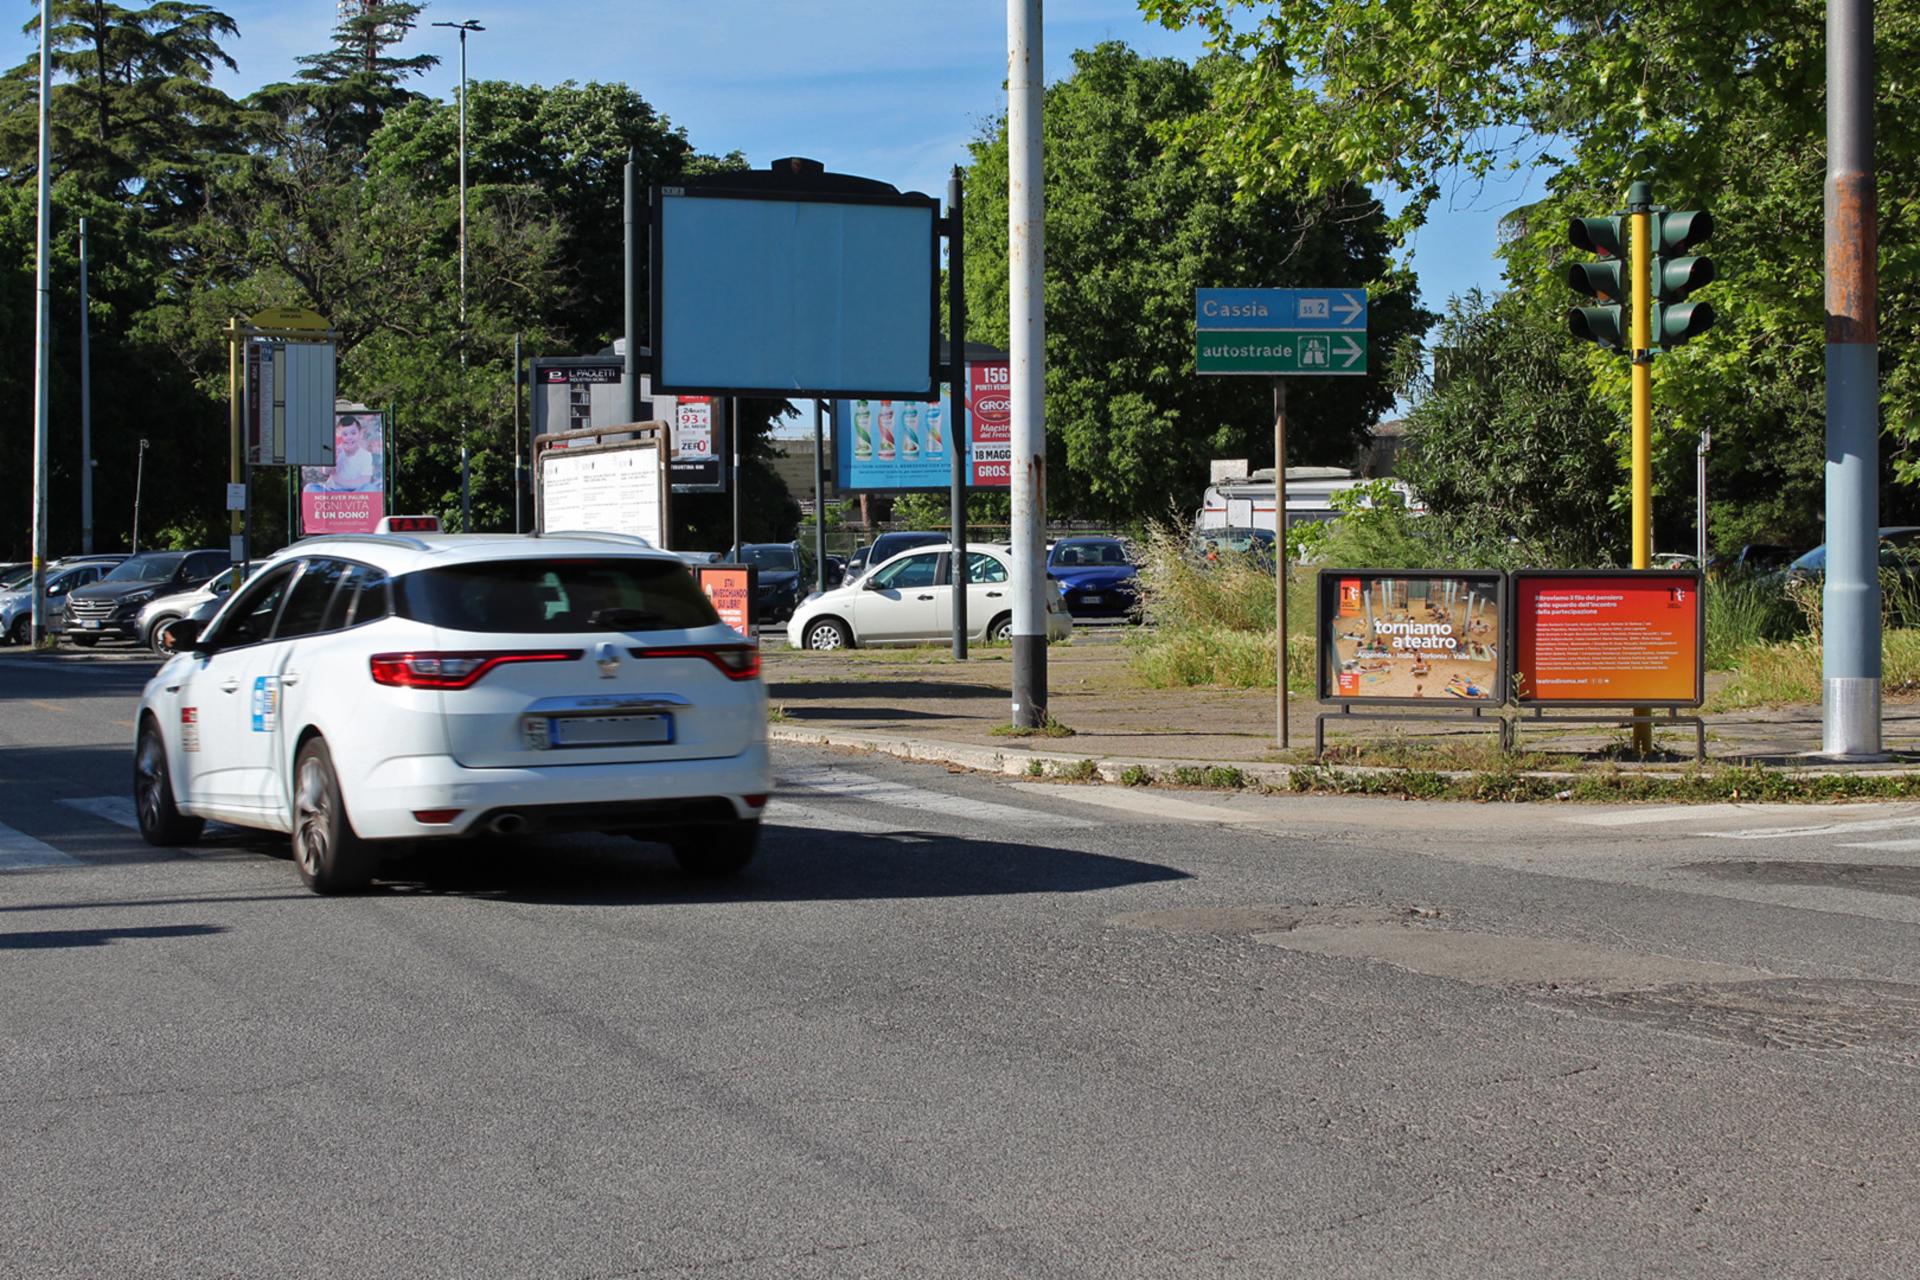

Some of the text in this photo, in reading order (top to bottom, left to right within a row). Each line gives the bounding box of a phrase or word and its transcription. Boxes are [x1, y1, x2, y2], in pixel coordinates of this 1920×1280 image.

[1203, 300, 1269, 317] Cassia
[1318, 302, 1325, 314] 2
[1203, 344, 1293, 358] autostrade
[576, 368, 615, 377] PAOLETTI
[984, 367, 1009, 384] 156
[975, 383, 1011, 391] PUNTI VEND
[979, 400, 1011, 411] GROS
[681, 414, 699, 424] 93
[975, 449, 1011, 460] 18 MAGG
[314, 501, 370, 511] OGNI VITA
[314, 510, 369, 519] È UN DONO!
[389, 518, 438, 531] TAXI
[1375, 620, 1453, 636] torniamo
[1392, 635, 1457, 649] a teatro
[1356, 652, 1392, 660] Argentina
[1419, 652, 1448, 660] Torlonia
